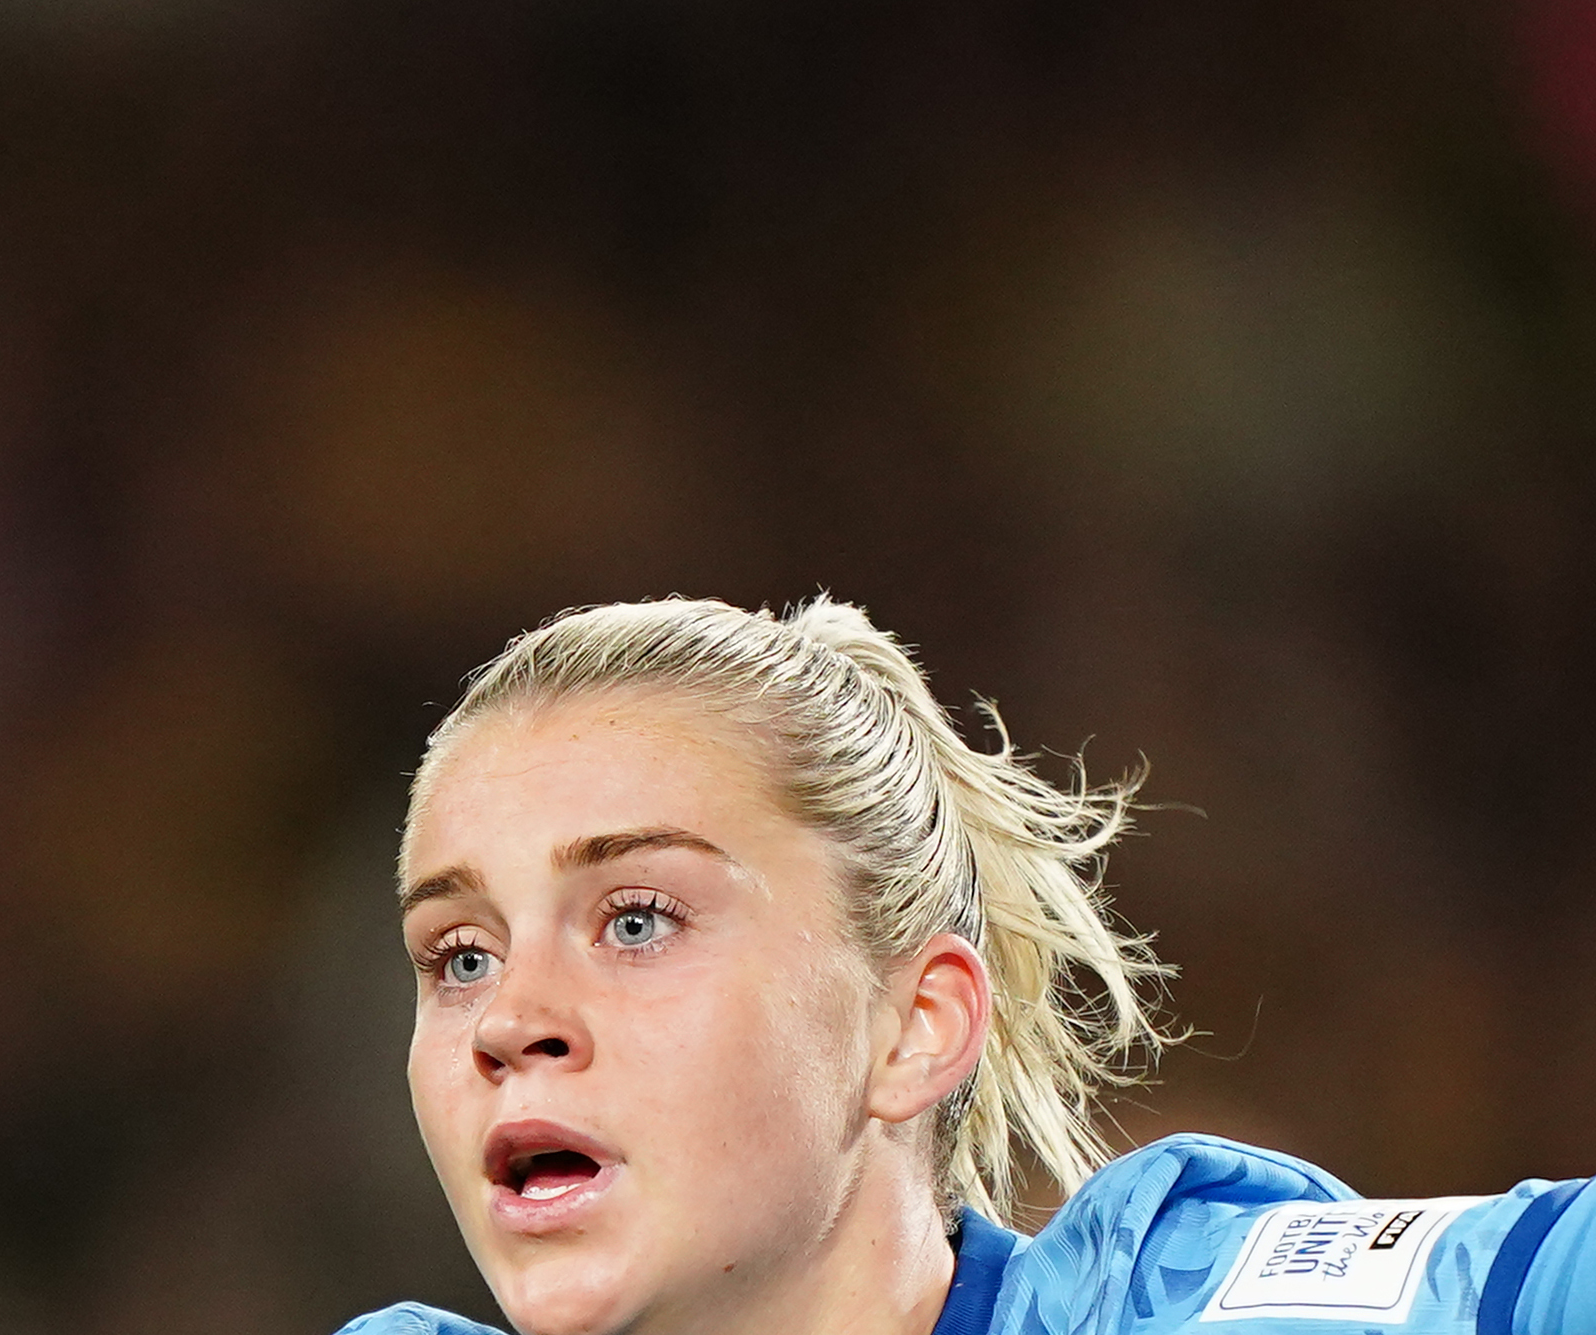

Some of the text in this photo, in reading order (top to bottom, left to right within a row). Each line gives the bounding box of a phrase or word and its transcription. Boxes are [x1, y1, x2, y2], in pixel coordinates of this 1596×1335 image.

[1258, 1214, 1316, 1278] FOOTB
[1374, 1209, 1424, 1246] FIFA
[1322, 1243, 1357, 1281] the
